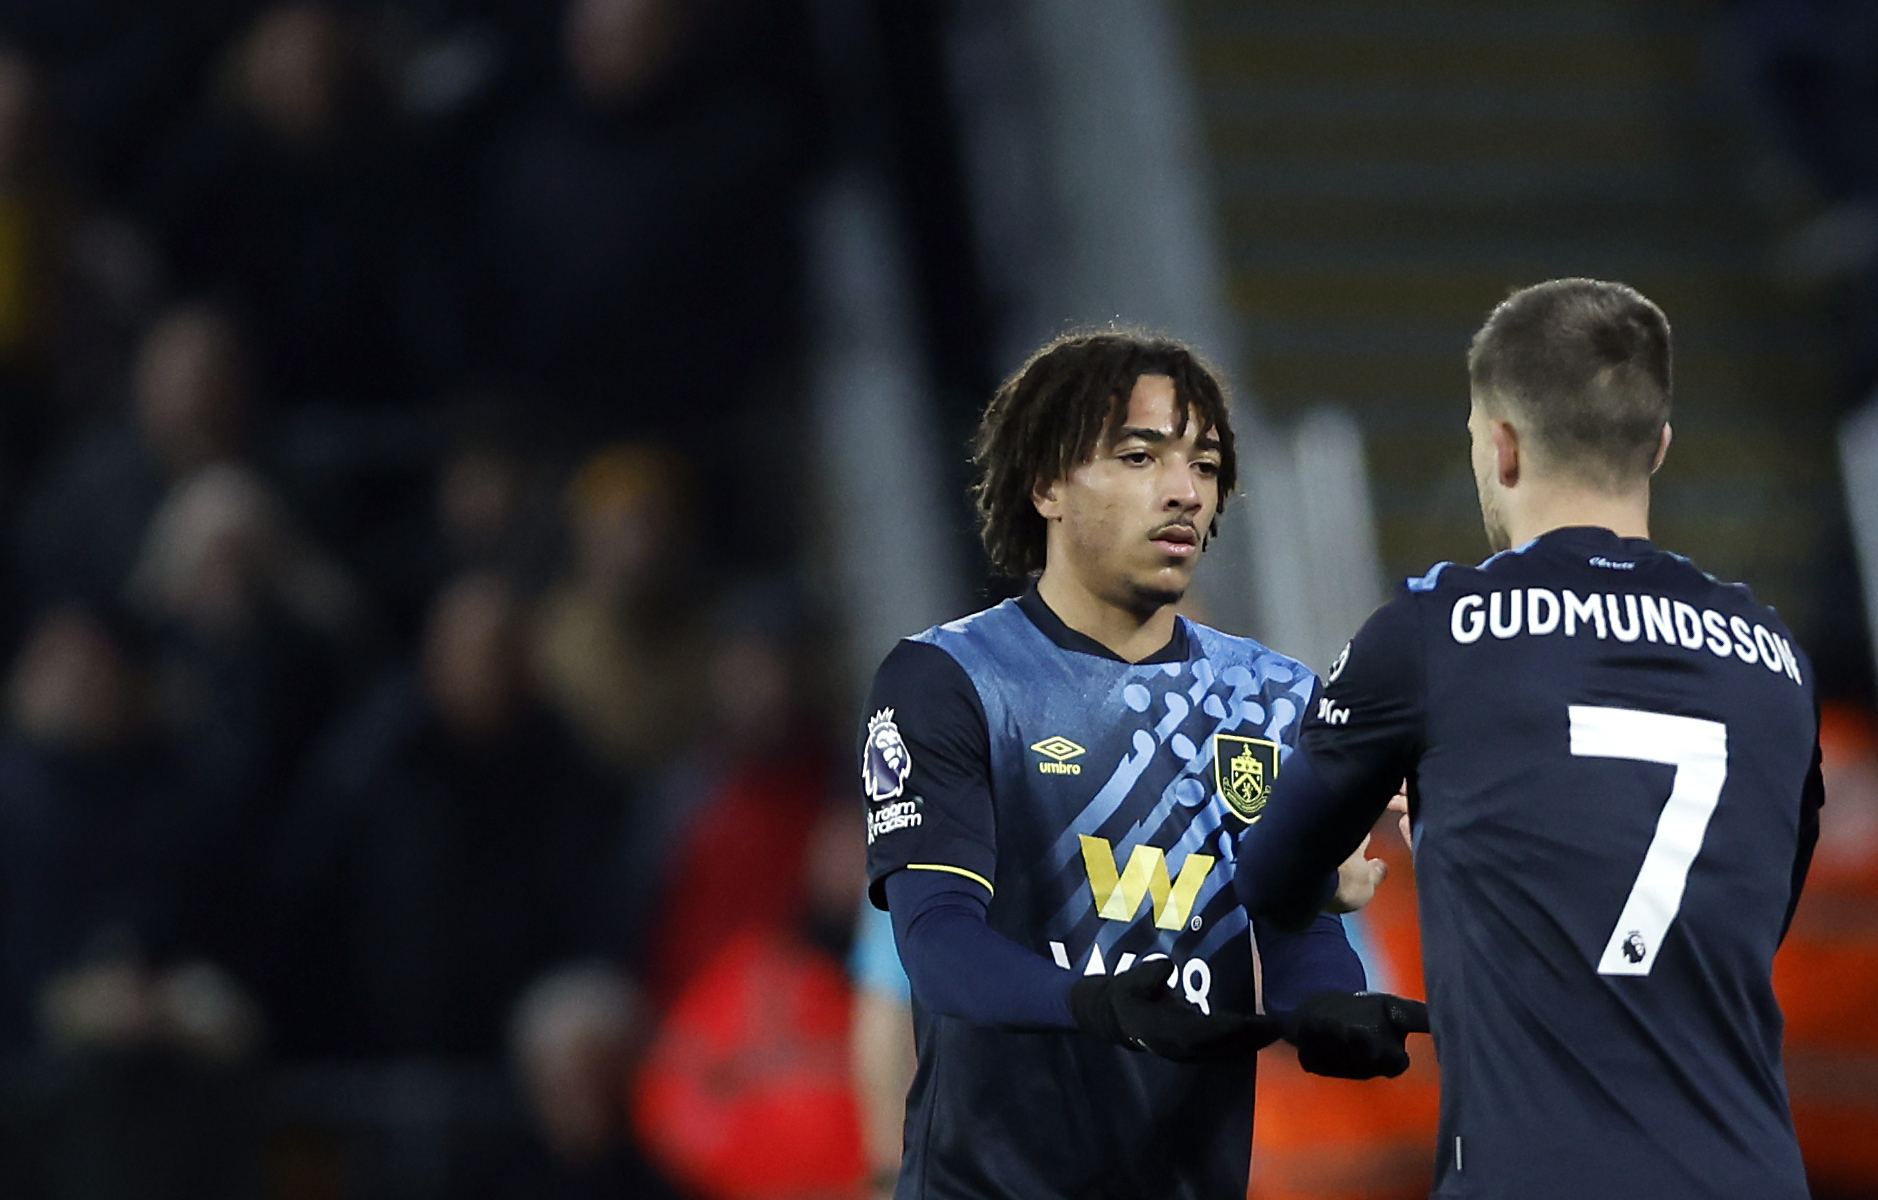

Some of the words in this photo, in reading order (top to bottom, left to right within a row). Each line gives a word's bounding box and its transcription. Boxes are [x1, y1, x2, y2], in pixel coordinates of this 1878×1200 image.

[1450, 586, 1802, 687] GUDMUNDSSON
[1038, 760, 1082, 776] umbro
[1567, 704, 1728, 977] 7
